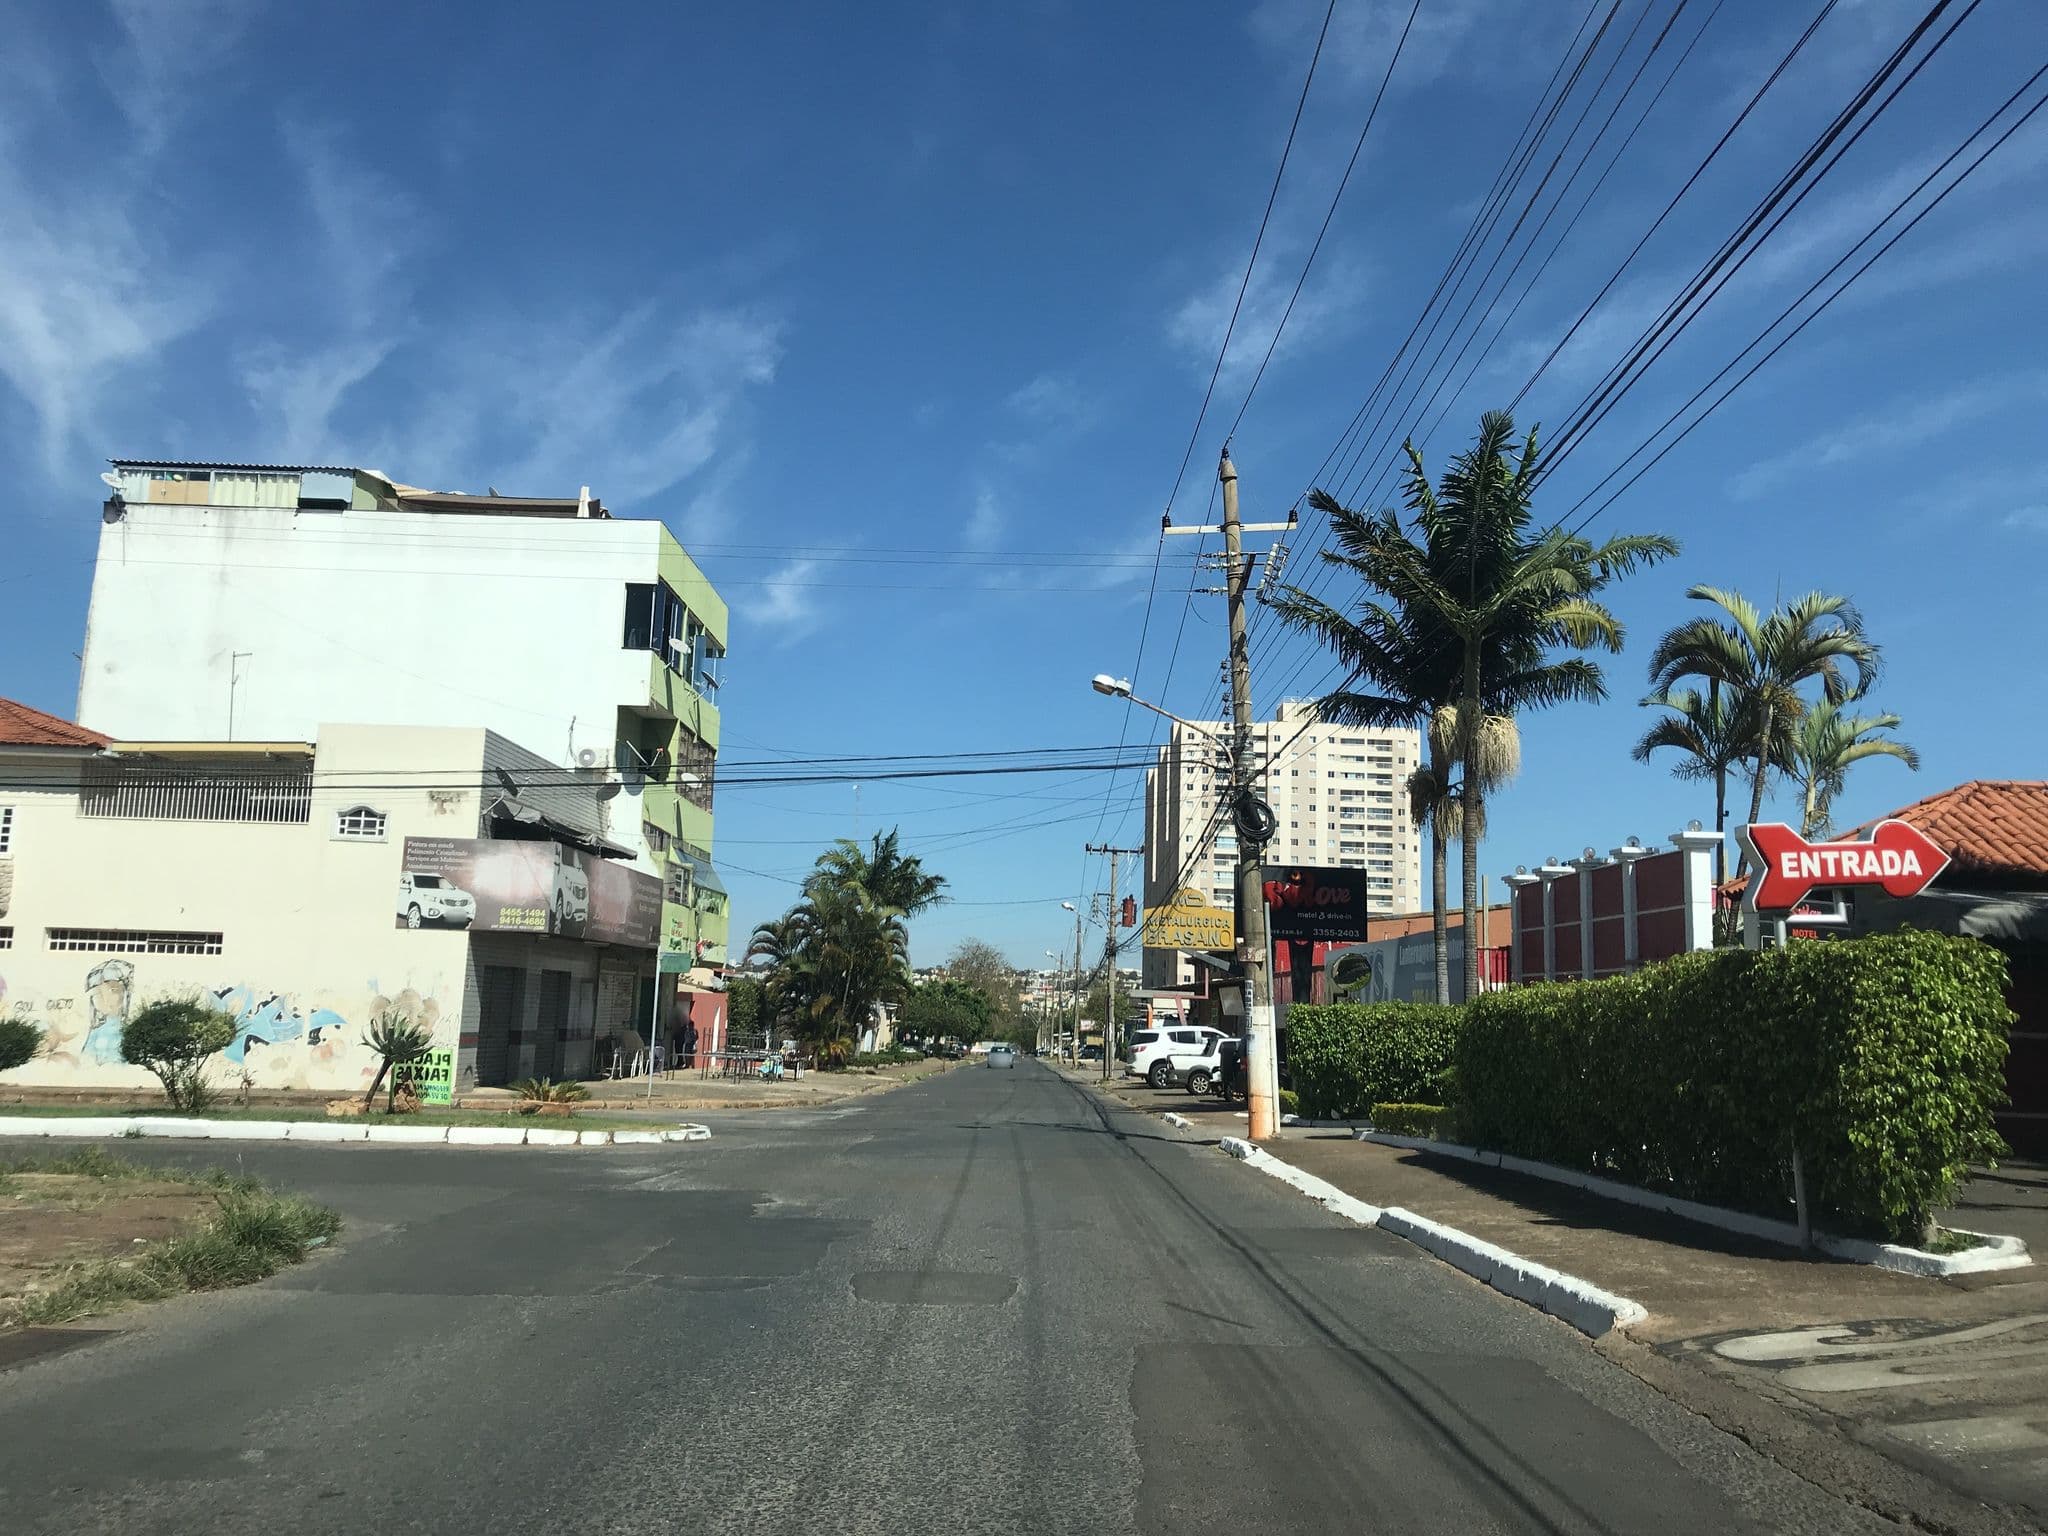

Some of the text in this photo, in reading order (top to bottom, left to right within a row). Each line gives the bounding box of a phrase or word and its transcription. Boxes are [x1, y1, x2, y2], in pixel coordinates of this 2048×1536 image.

[1781, 849, 1923, 878] ENTRADA
[500, 907, 546, 917] 8455-1494
[1297, 911, 1318, 919] motel
[1147, 915, 1231, 928] METALURGICA
[1146, 929, 1232, 948] BRASANO
[1312, 928, 1360, 938] 3355-2403
[1792, 928, 1819, 939] MOTEL
